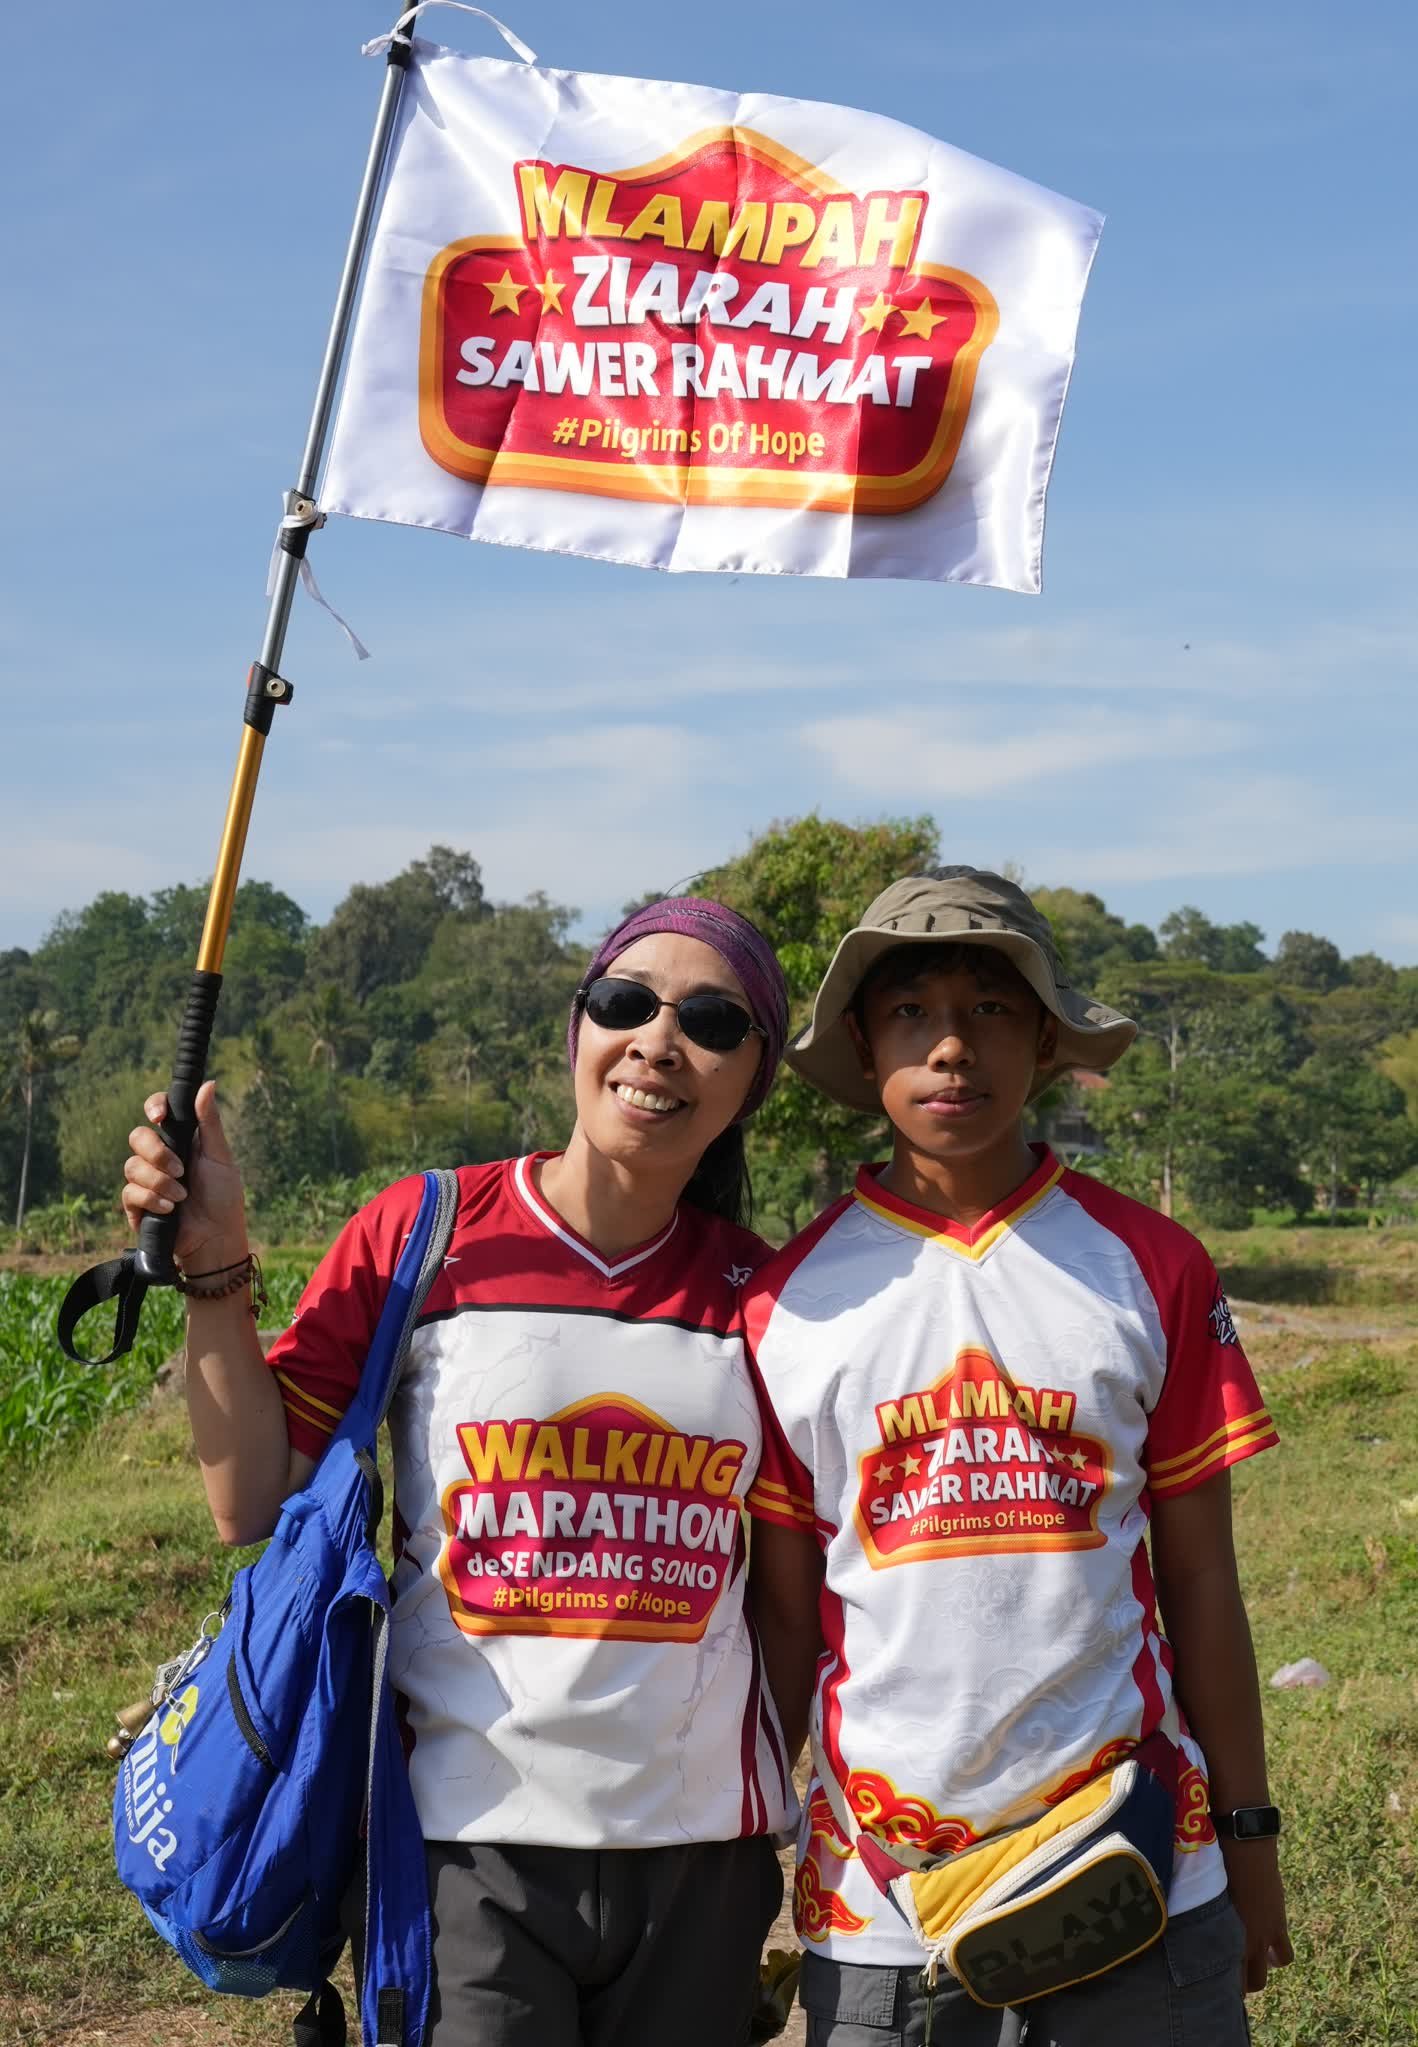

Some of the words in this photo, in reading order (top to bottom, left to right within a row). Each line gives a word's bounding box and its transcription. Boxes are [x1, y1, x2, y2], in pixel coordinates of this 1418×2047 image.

[518, 166, 923, 270] MLAMPAH
[572, 255, 858, 344] ZIARAH
[455, 336, 659, 398] SAWER
[672, 343, 933, 408] RAHMAT
[552, 418, 702, 460] #Pilgrims
[708, 421, 746, 454] Of
[748, 422, 826, 463] Hope
[459, 1423, 744, 1496] WALKING
[456, 1490, 738, 1556] MARATHON
[909, 1512, 991, 1536] #Pilgrims
[995, 1511, 1016, 1528] Of
[1019, 1510, 1065, 1529] Hope
[466, 1551, 644, 1581] deSENDANG
[650, 1557, 718, 1591] SONO
[492, 1587, 609, 1616] #Pilgrims
[968, 1871, 1153, 1987] PLAY!
